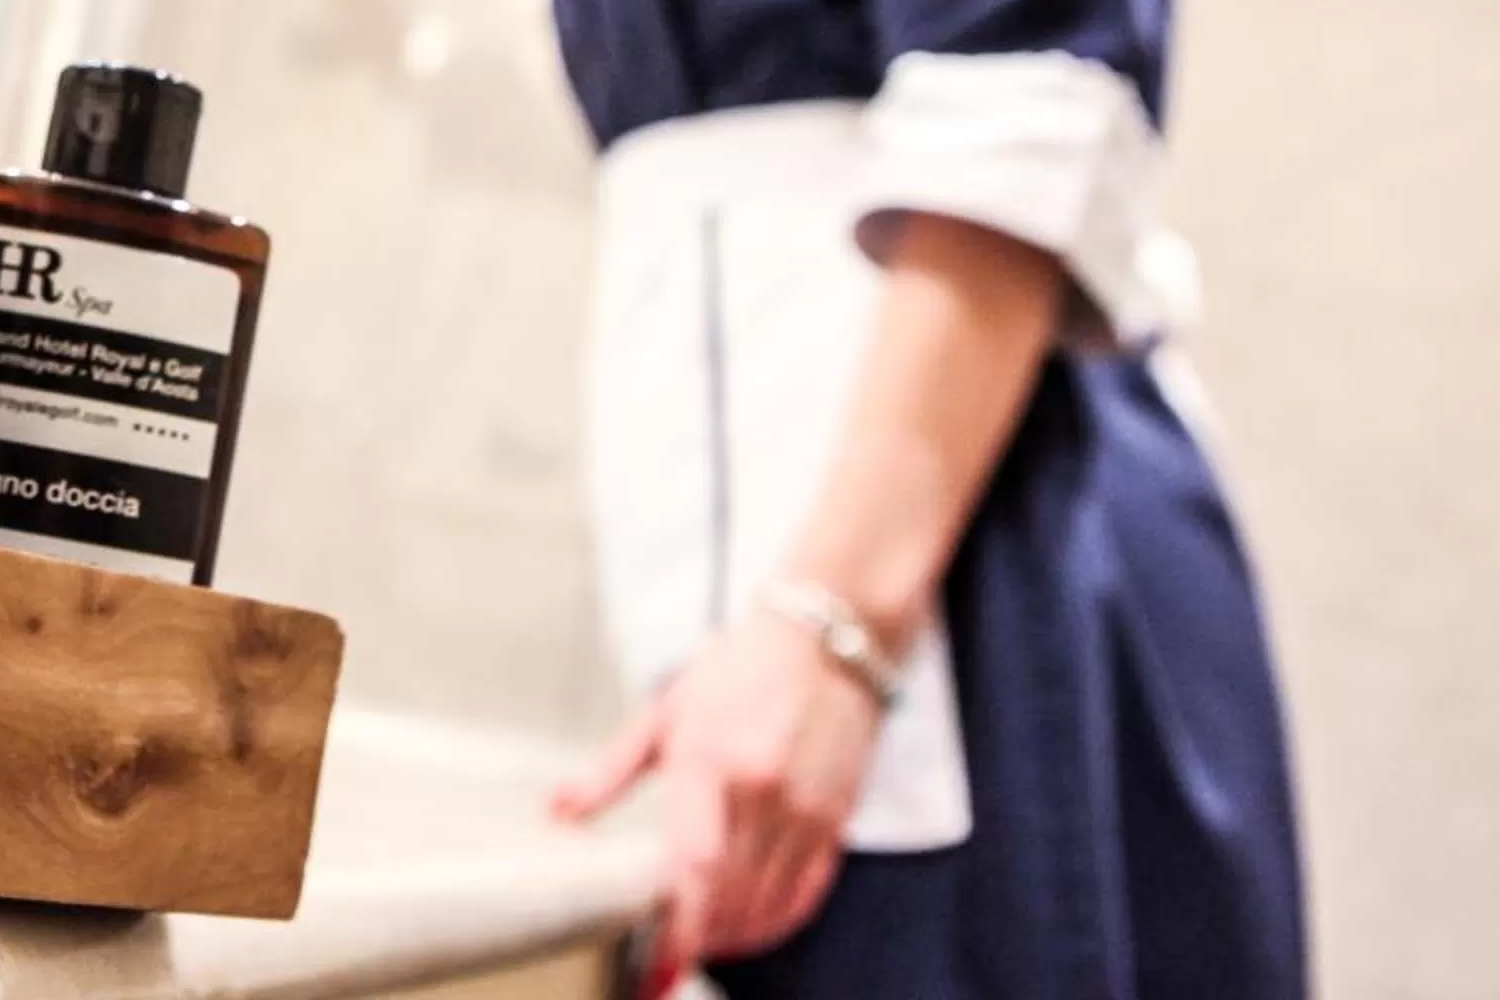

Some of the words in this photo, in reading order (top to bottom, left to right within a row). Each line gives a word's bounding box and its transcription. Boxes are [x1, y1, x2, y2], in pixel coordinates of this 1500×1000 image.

[64, 286, 115, 318] Spa
[34, 335, 88, 359] Hotel
[90, 344, 145, 374] Royal
[164, 358, 204, 381] Golf
[91, 365, 132, 388] Valle
[45, 479, 142, 519] doccia
